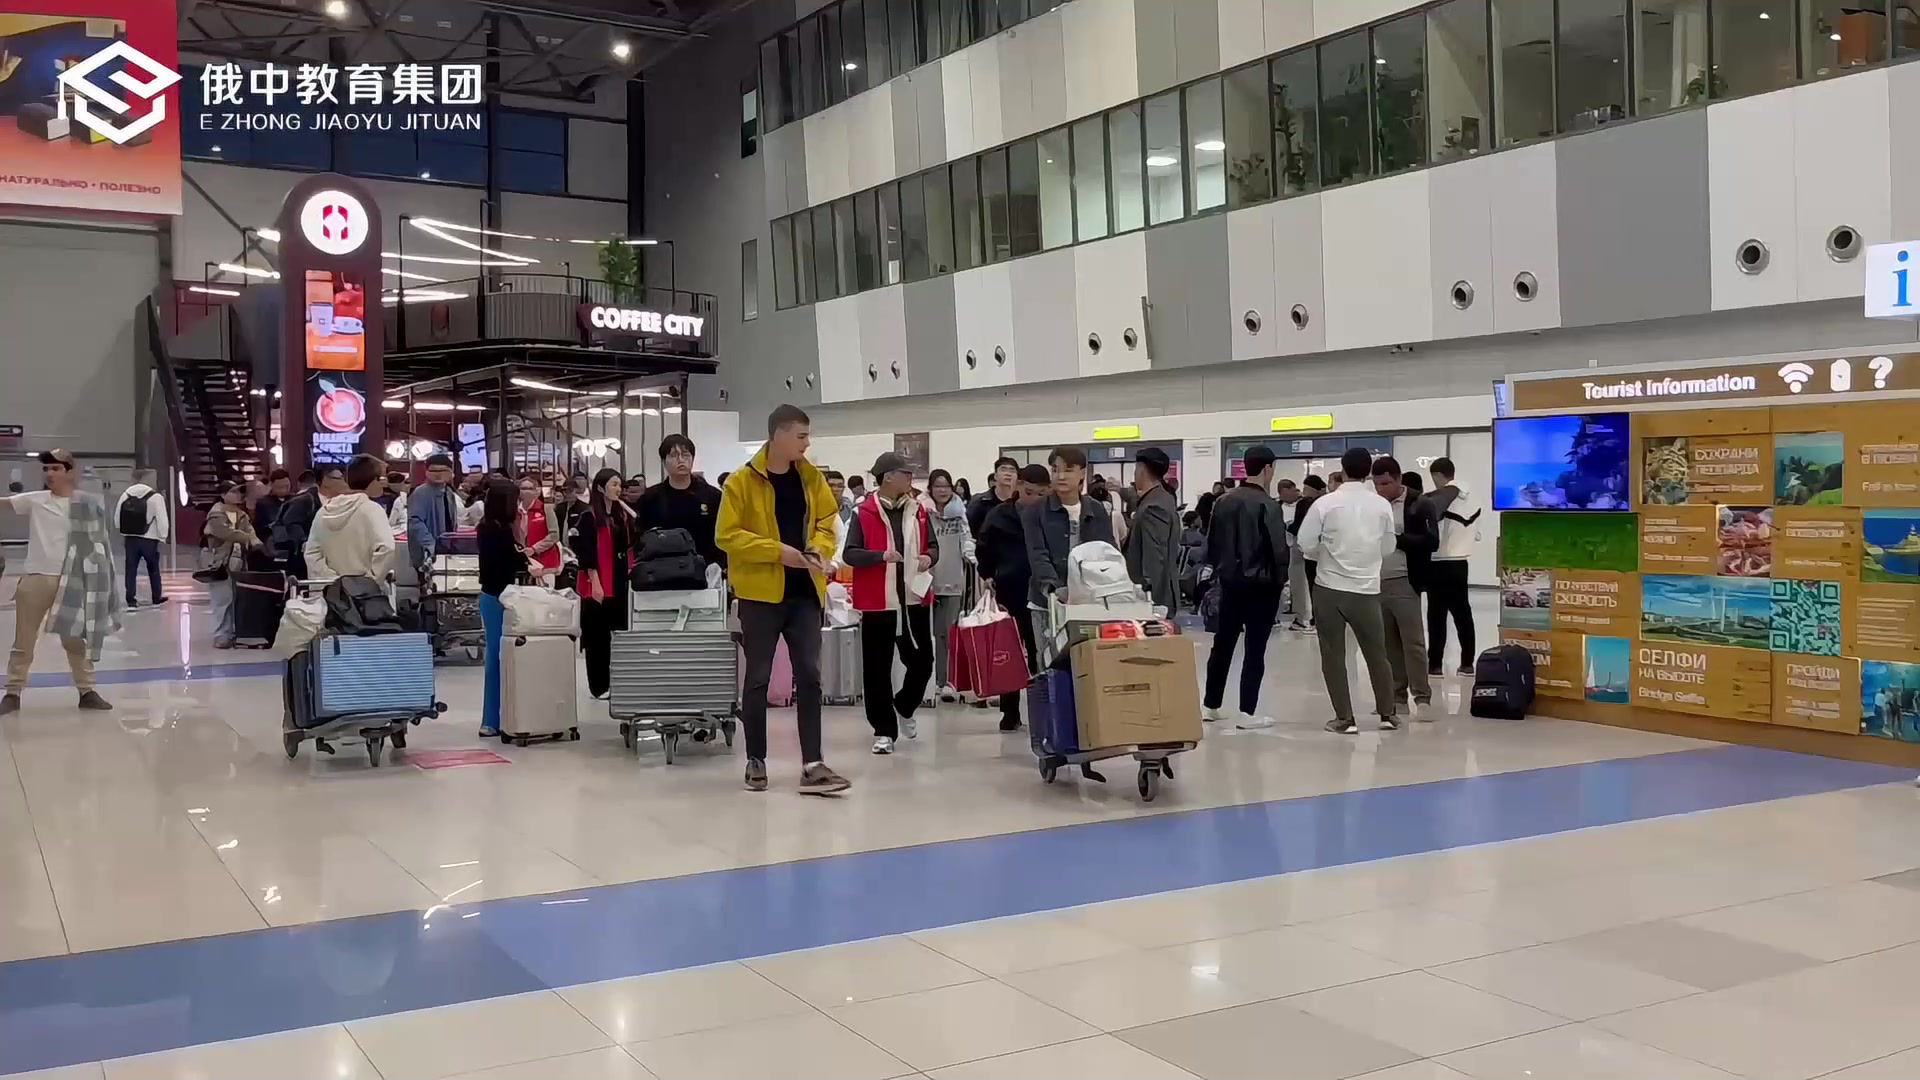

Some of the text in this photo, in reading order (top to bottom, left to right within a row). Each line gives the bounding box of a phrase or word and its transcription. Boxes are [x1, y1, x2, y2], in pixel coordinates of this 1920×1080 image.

[100, 181, 161, 195] ПОЛЕЗНО
[590, 306, 704, 337] COFFEE CITY
[1582, 373, 1756, 400] Tourist Information
[1639, 648, 1707, 671] СЕЛФИ
